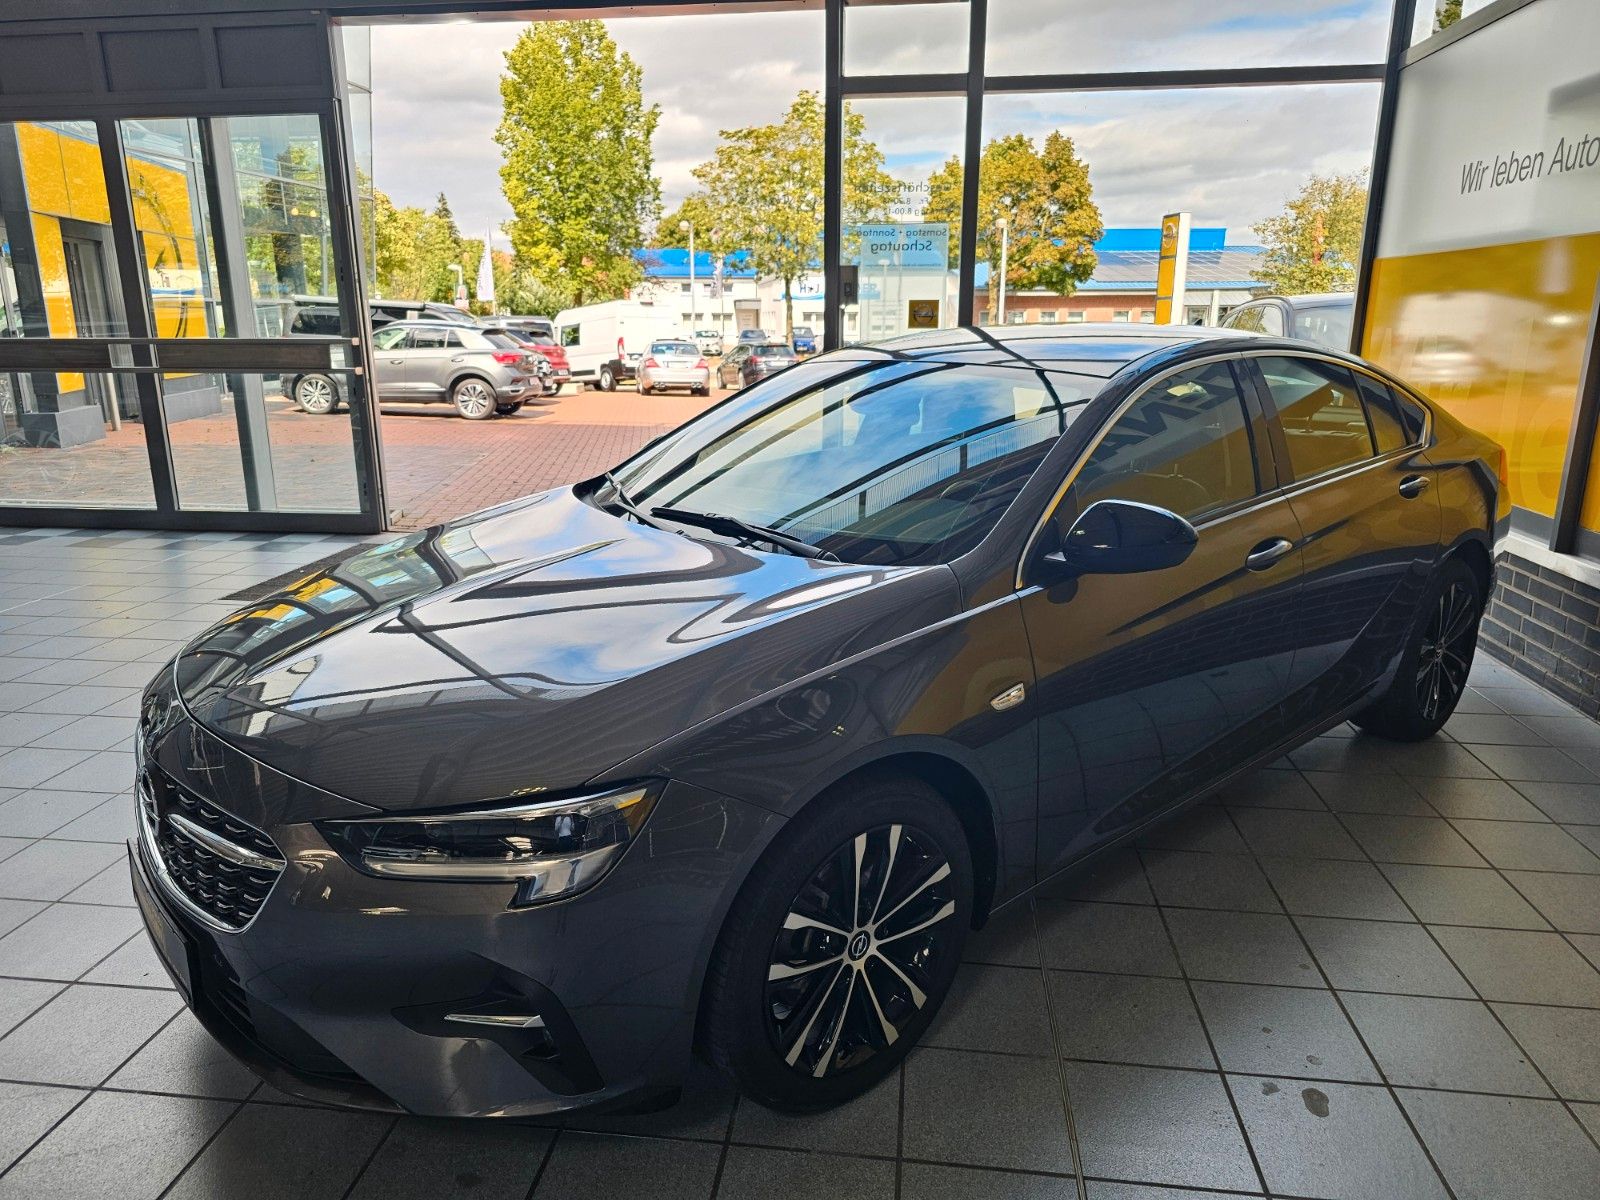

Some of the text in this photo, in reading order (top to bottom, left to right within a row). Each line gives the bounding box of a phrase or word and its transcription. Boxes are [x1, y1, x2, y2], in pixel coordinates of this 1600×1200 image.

[1461, 134, 1600, 195] Wir leben Auto
